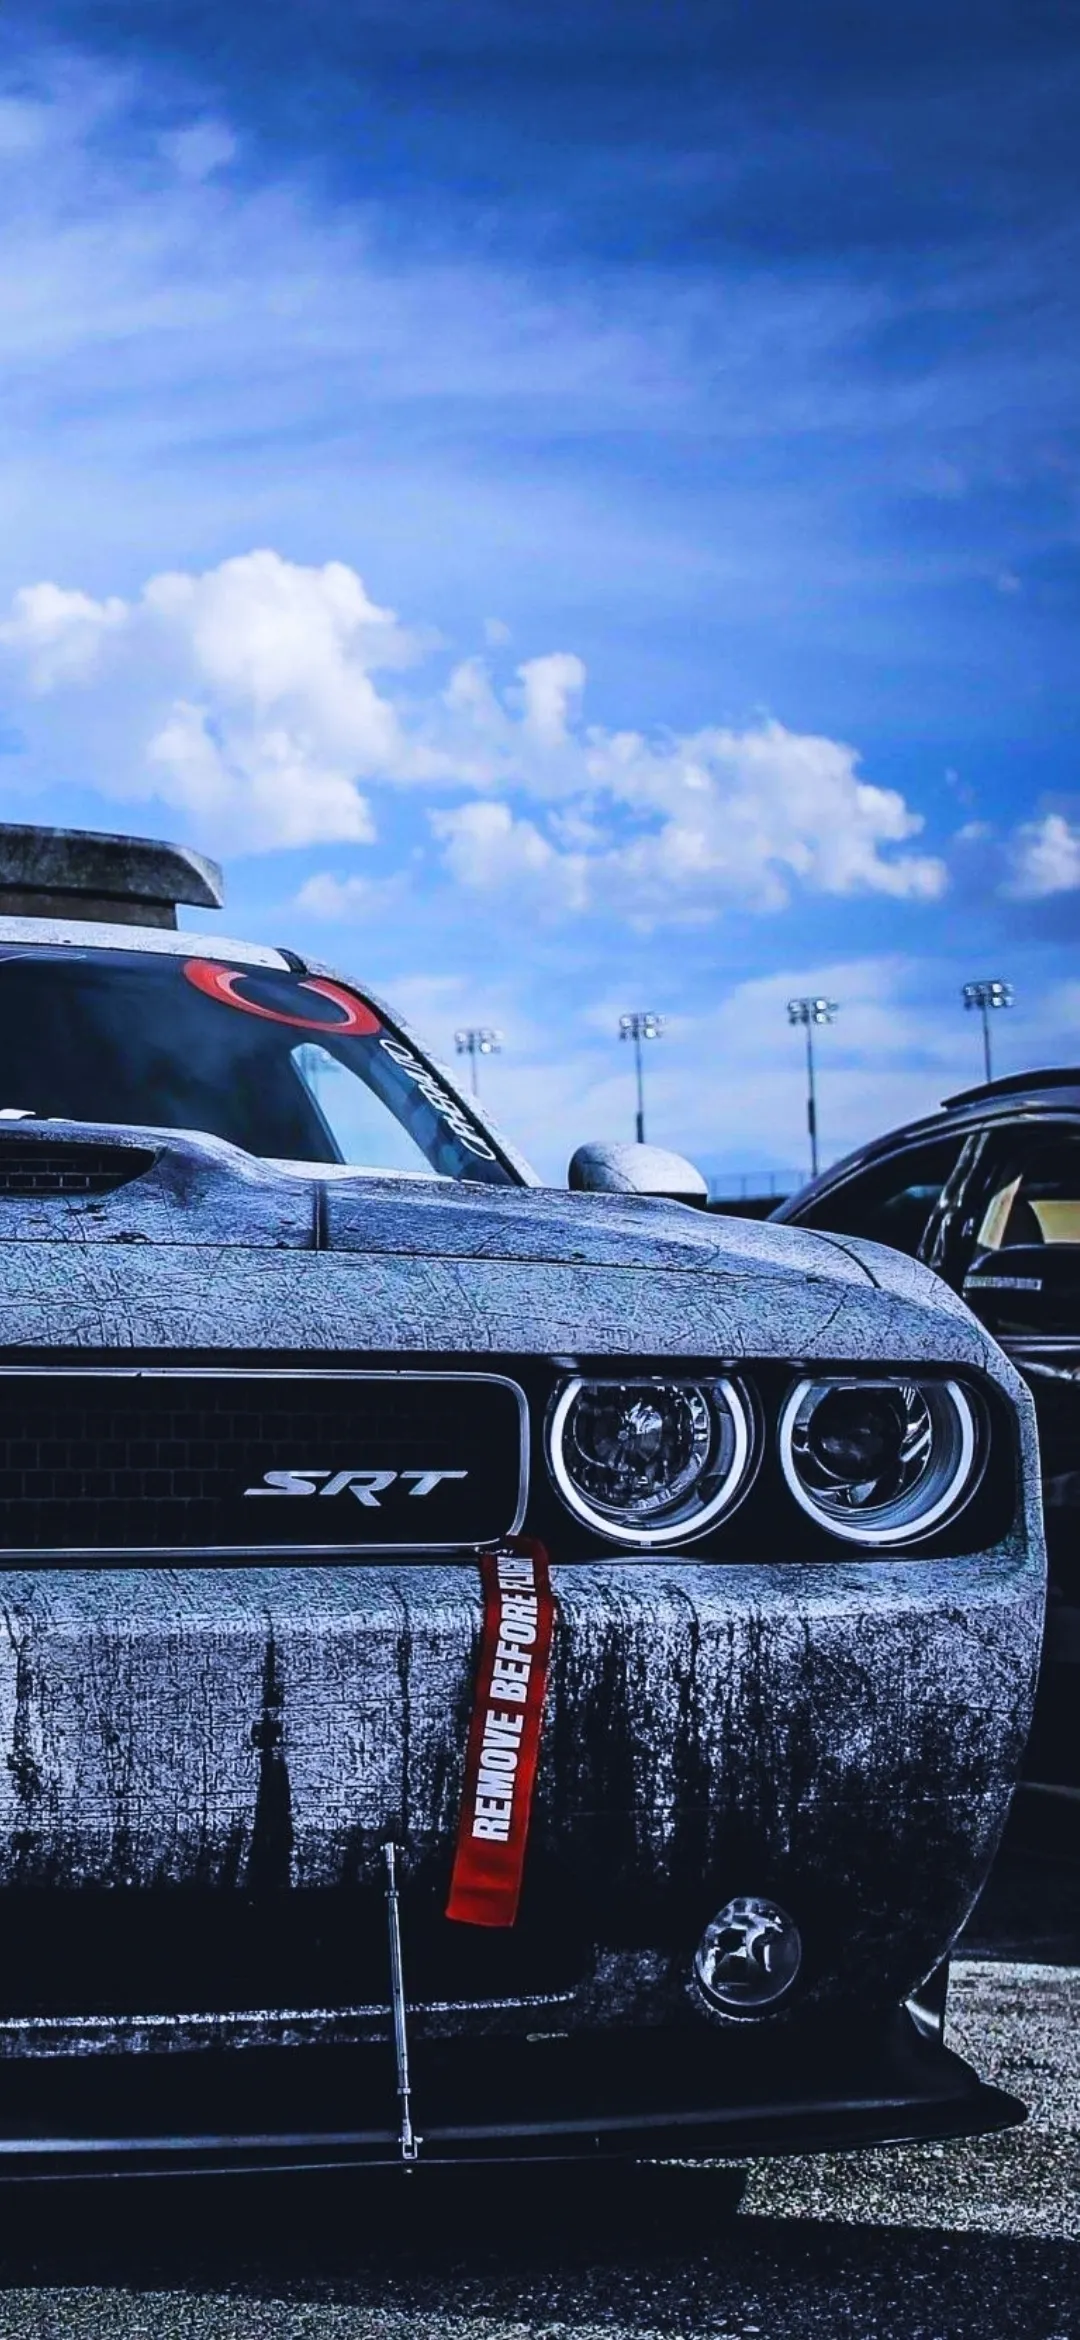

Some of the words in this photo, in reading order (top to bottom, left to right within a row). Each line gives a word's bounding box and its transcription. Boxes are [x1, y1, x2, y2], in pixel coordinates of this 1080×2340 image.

[243, 1470, 469, 1507] SRT
[489, 1593, 538, 1703] BEFORE
[471, 1709, 525, 1842] REMOVE
